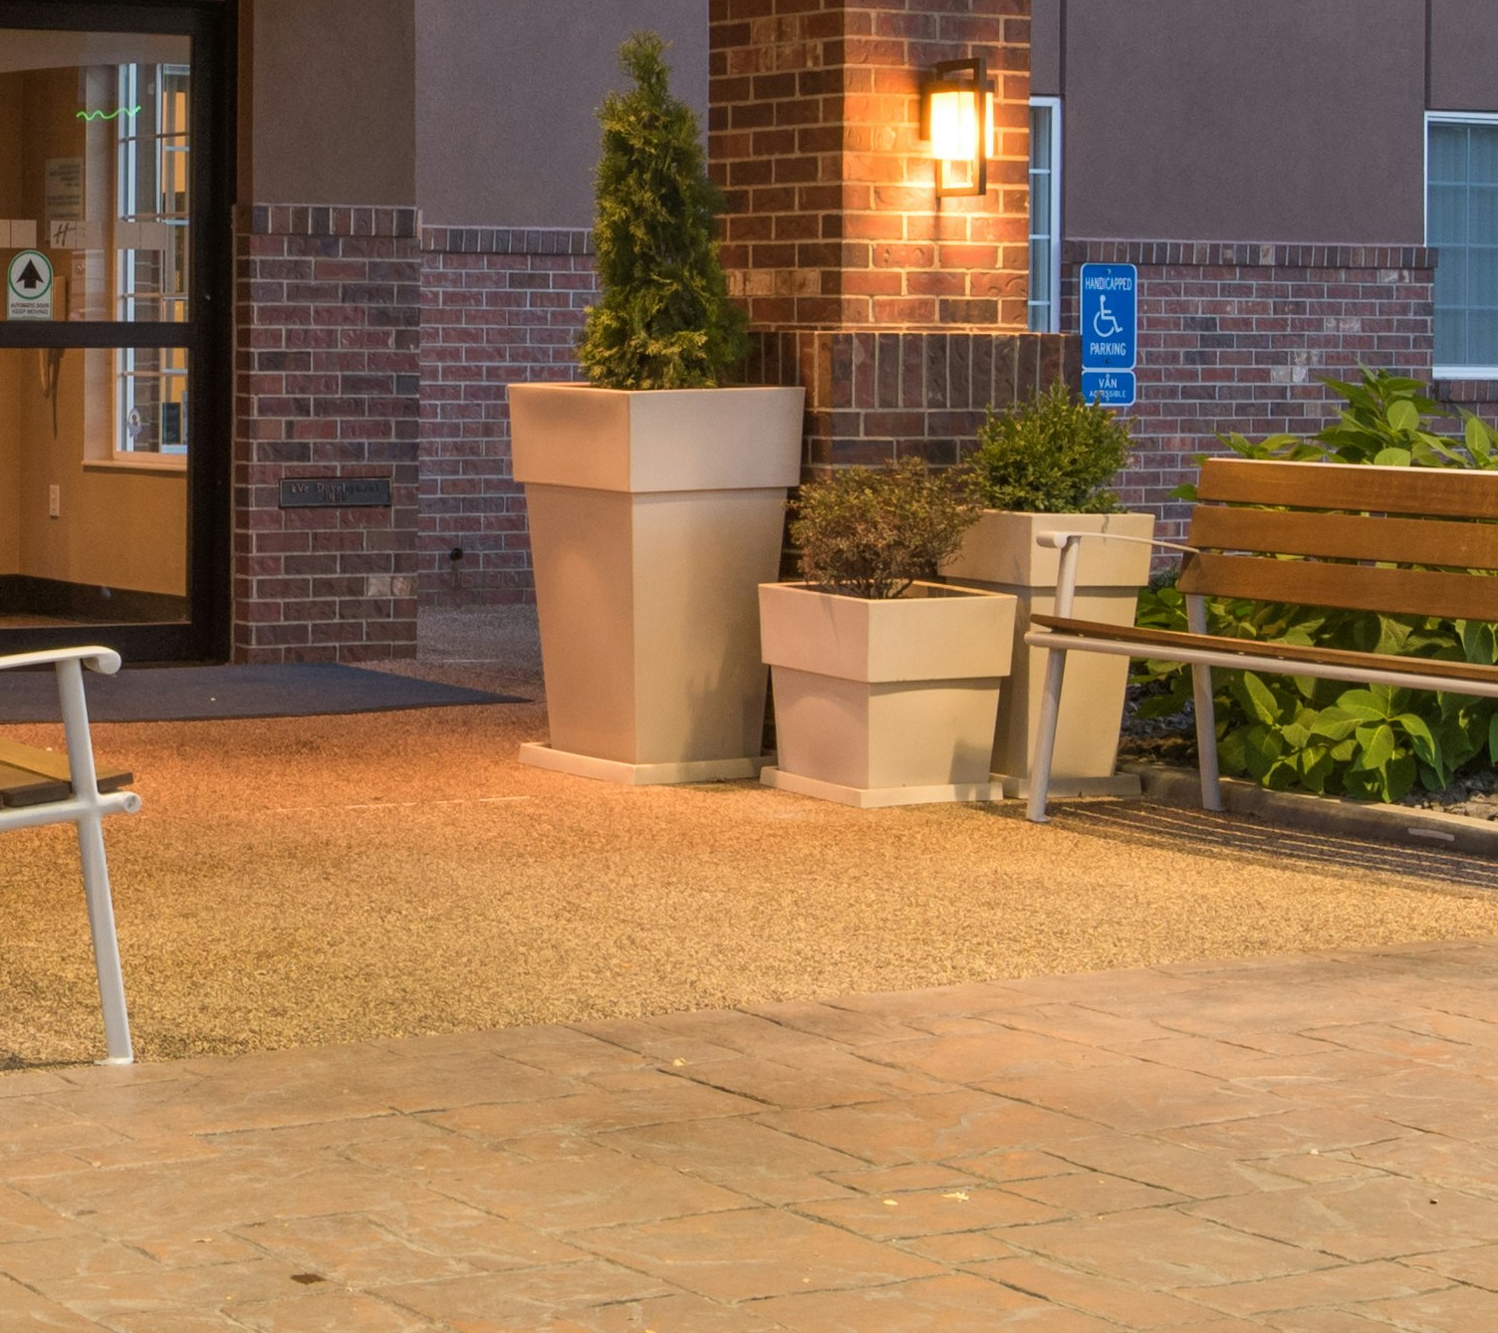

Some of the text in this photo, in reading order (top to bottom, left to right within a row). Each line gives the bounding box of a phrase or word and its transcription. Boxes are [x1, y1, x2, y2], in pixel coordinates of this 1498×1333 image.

[1085, 276, 1133, 291] HANDICAPPED
[1090, 342, 1127, 356] PARKING
[1098, 378, 1118, 389] VAN
